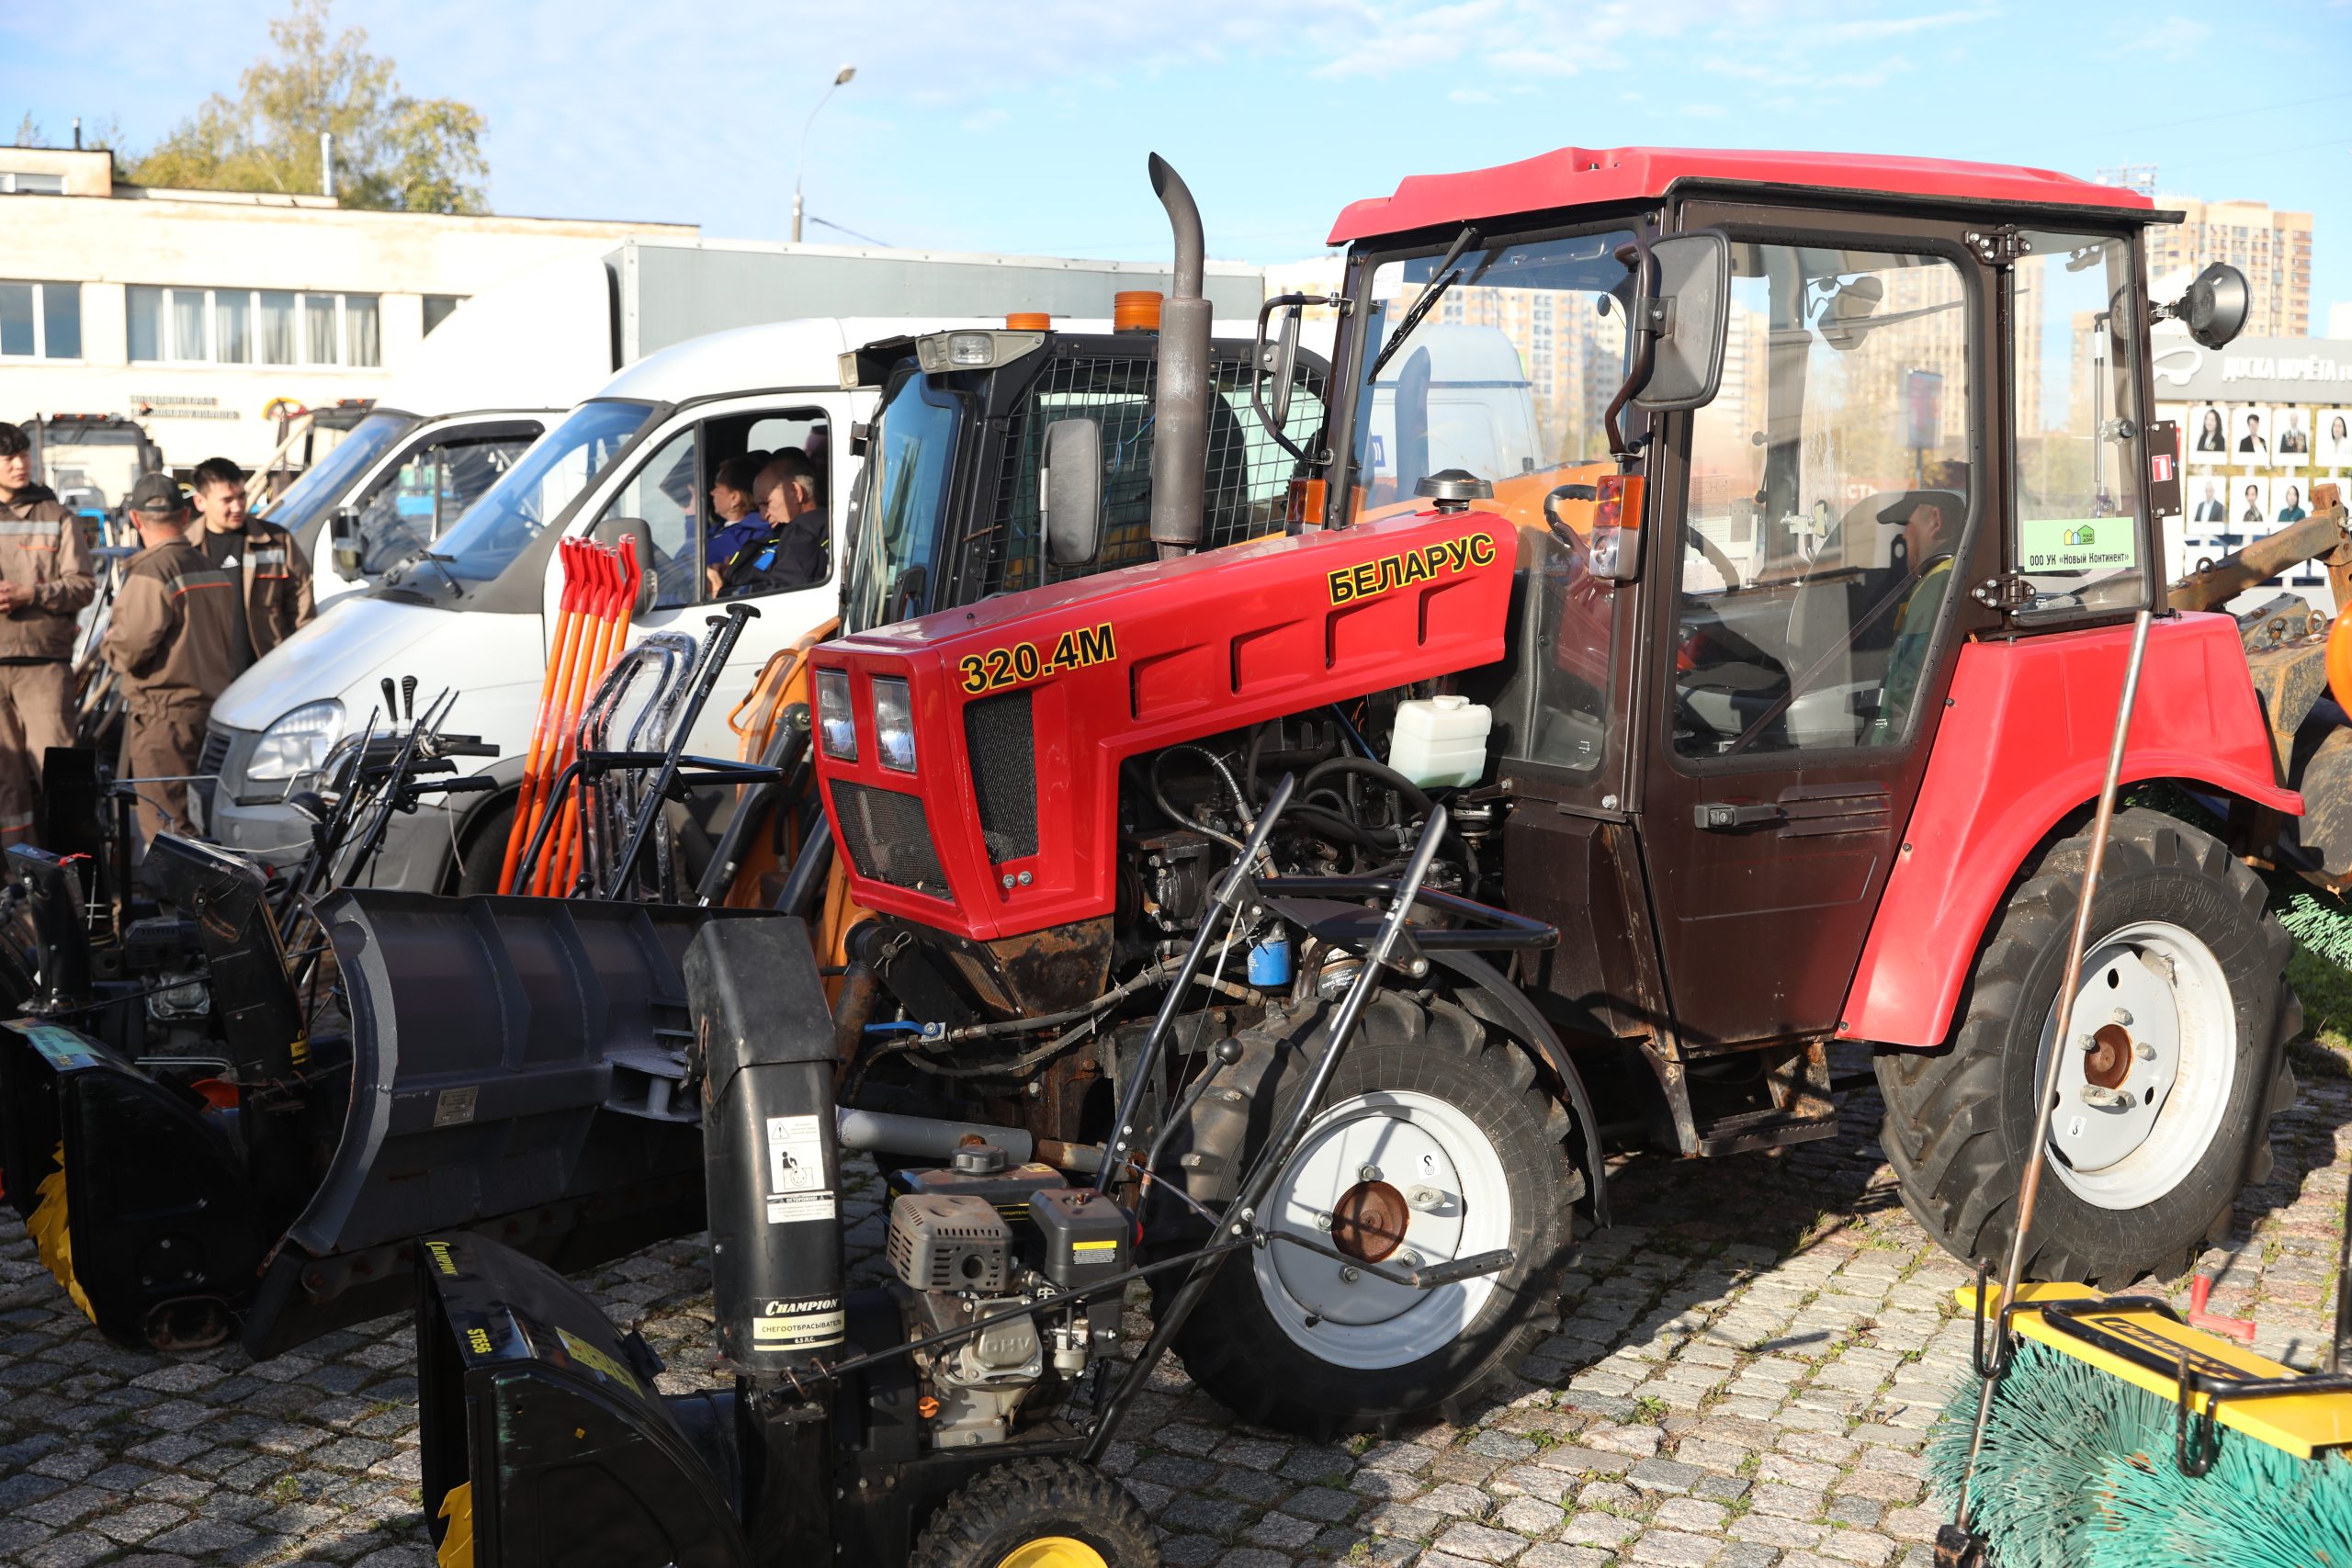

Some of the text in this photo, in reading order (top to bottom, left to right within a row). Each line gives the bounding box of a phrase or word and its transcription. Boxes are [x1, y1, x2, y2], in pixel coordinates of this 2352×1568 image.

[1327, 532, 1497, 606] БЕЛАРУС
[2030, 552, 2130, 566] ООО УК «Новый Континент»
[765, 1299, 838, 1316] CHAMPION
[467, 1328, 492, 1354] ST656
